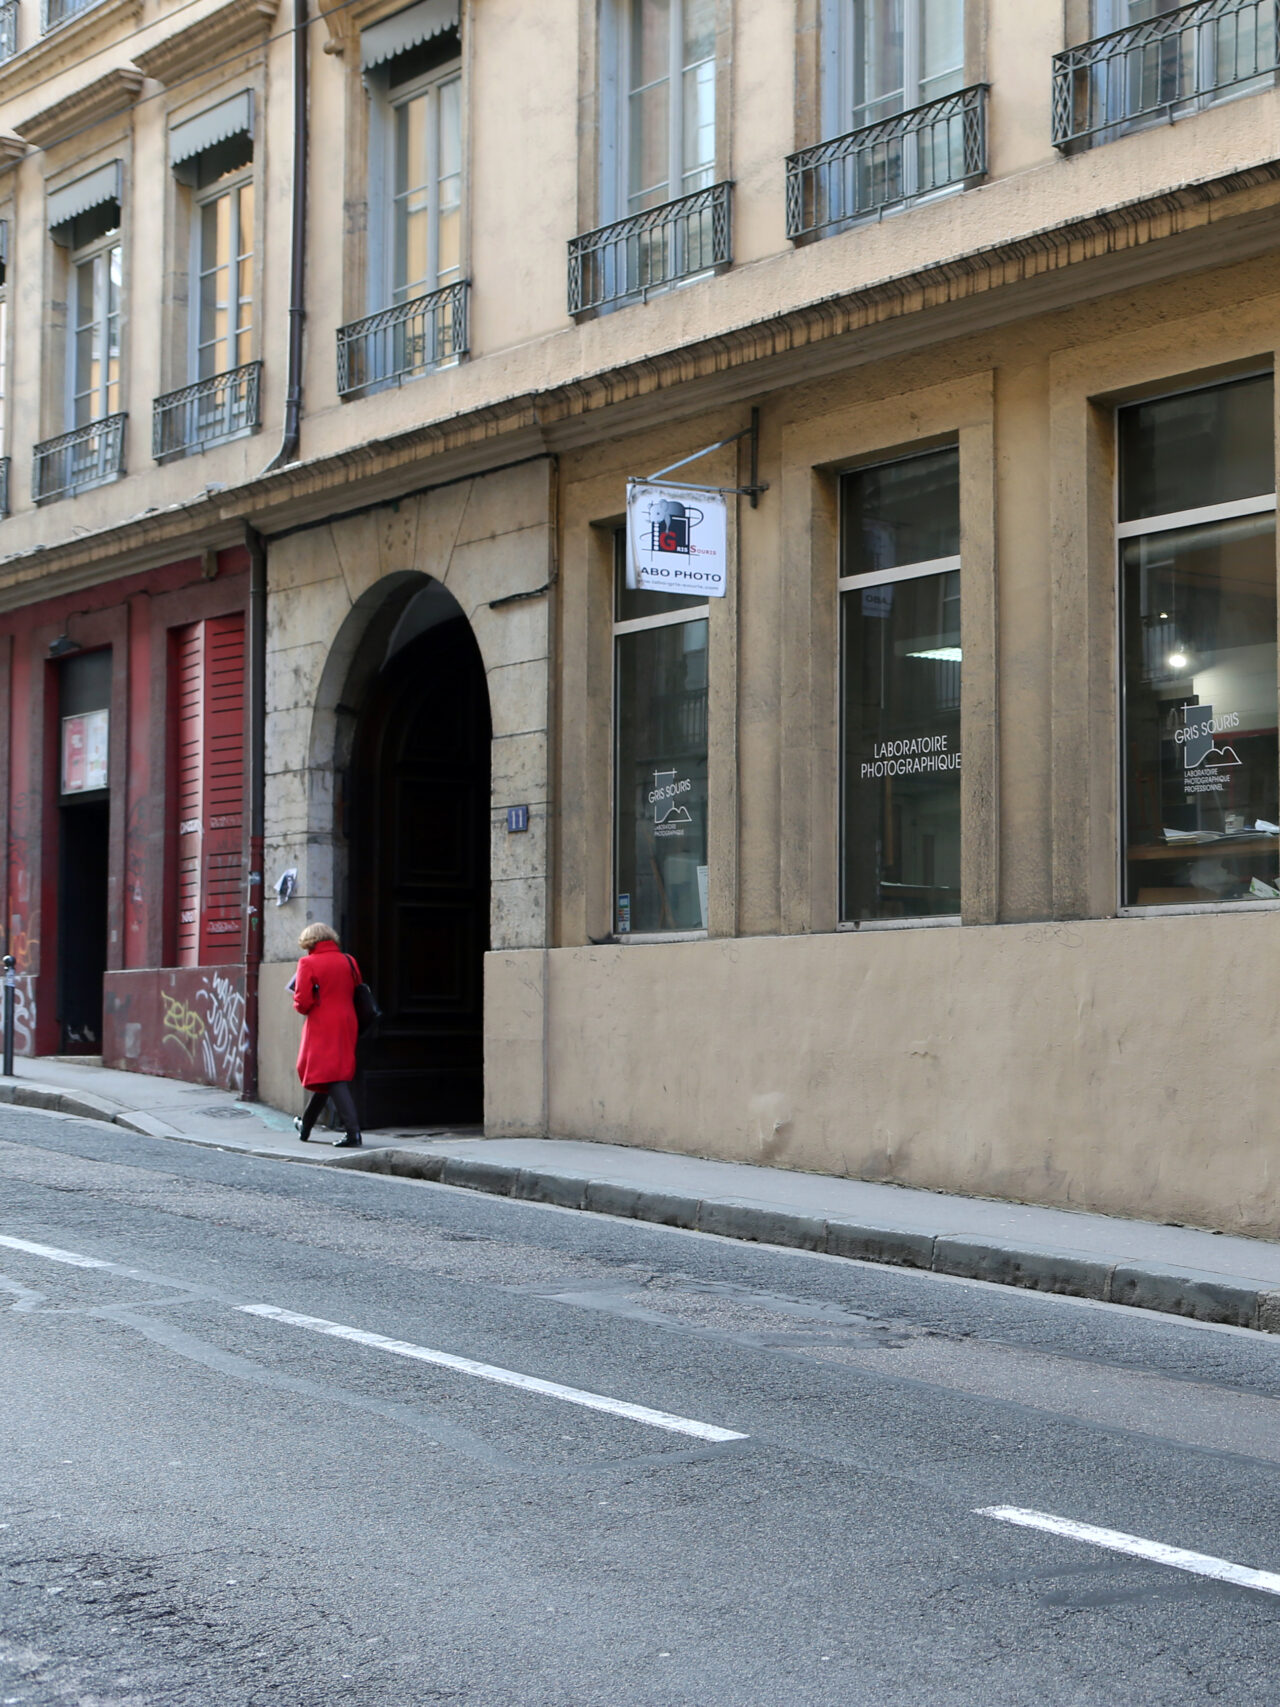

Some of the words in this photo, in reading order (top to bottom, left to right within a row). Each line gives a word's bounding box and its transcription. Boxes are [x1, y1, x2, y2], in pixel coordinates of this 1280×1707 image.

[639, 566, 670, 577] ABO
[674, 570, 722, 582] PHOTO
[1174, 724, 1199, 744] GRIS
[1201, 711, 1240, 736] SOURIS
[873, 735, 948, 759] LABORATOIRE
[860, 752, 962, 779] PHOTOGRAPHIQUE
[1184, 768, 1218, 778] LABORATOIRE
[1184, 774, 1231, 785] PHOTOGRAPHIQUE
[1184, 783, 1224, 793] PROFESSIONNEL
[648, 787, 665, 804] GRIS
[665, 778, 692, 798] SOURIS
[512, 809, 523, 829] 11
